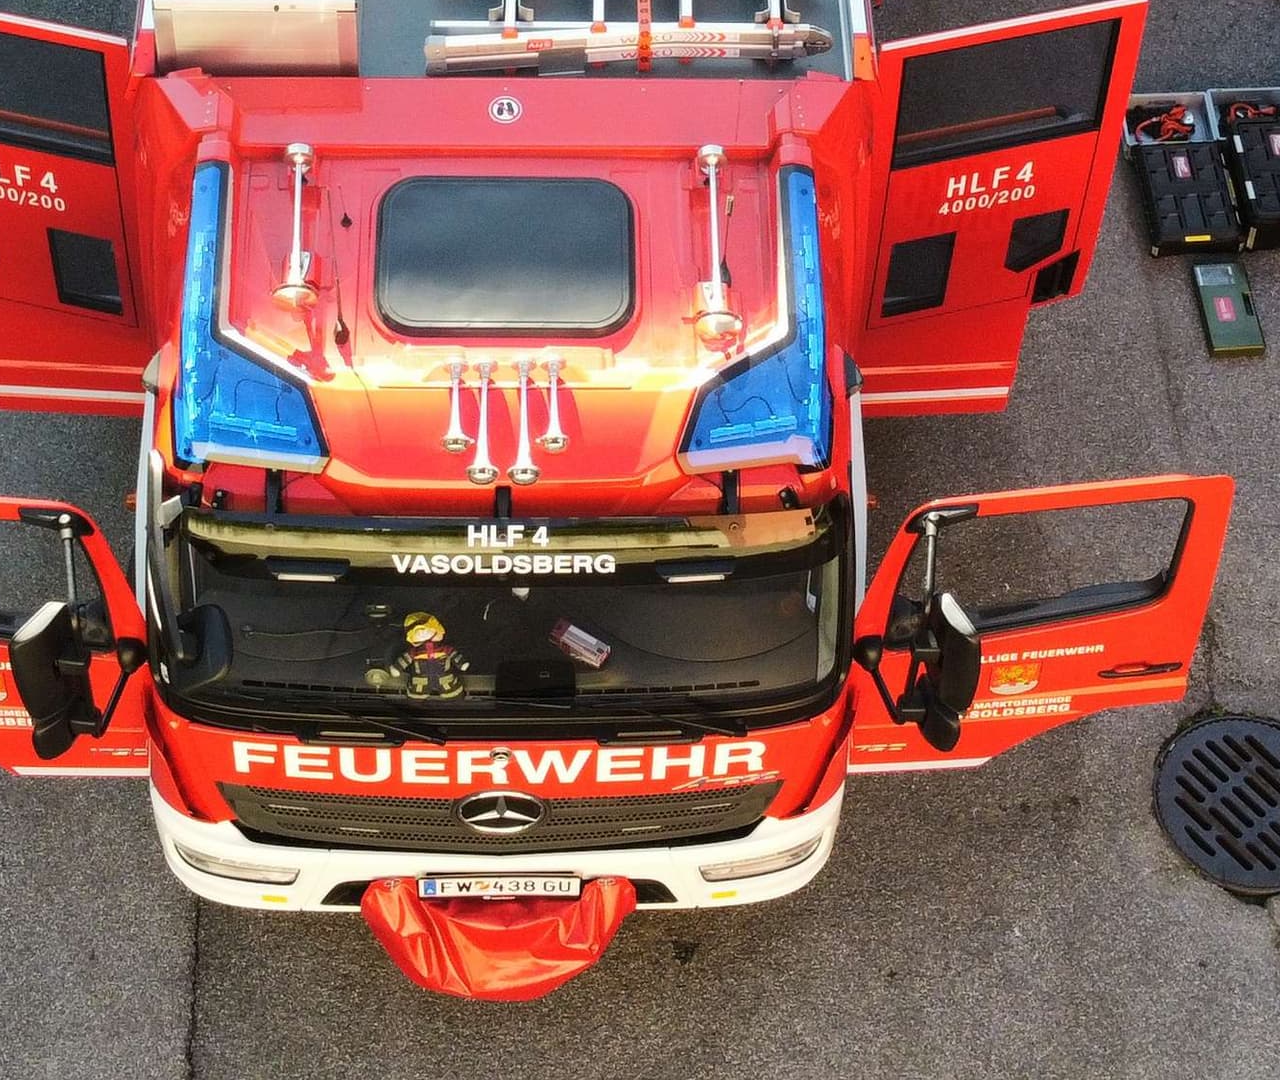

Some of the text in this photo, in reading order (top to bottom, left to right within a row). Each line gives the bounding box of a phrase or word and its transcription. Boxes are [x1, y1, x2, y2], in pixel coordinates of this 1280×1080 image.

[39, 171, 59, 194] 4
[946, 161, 1034, 199] HLF 4
[938, 184, 1036, 216] 4000/200
[466, 524, 550, 548] HLF 4
[391, 554, 616, 575] VASOLDSBERG
[1021, 644, 1105, 660] FEUERWEHR
[973, 696, 1072, 709] MARKTGEMEINDE
[232, 740, 767, 785] FEUERWEHR
[440, 880, 572, 894] FW 438 GU
